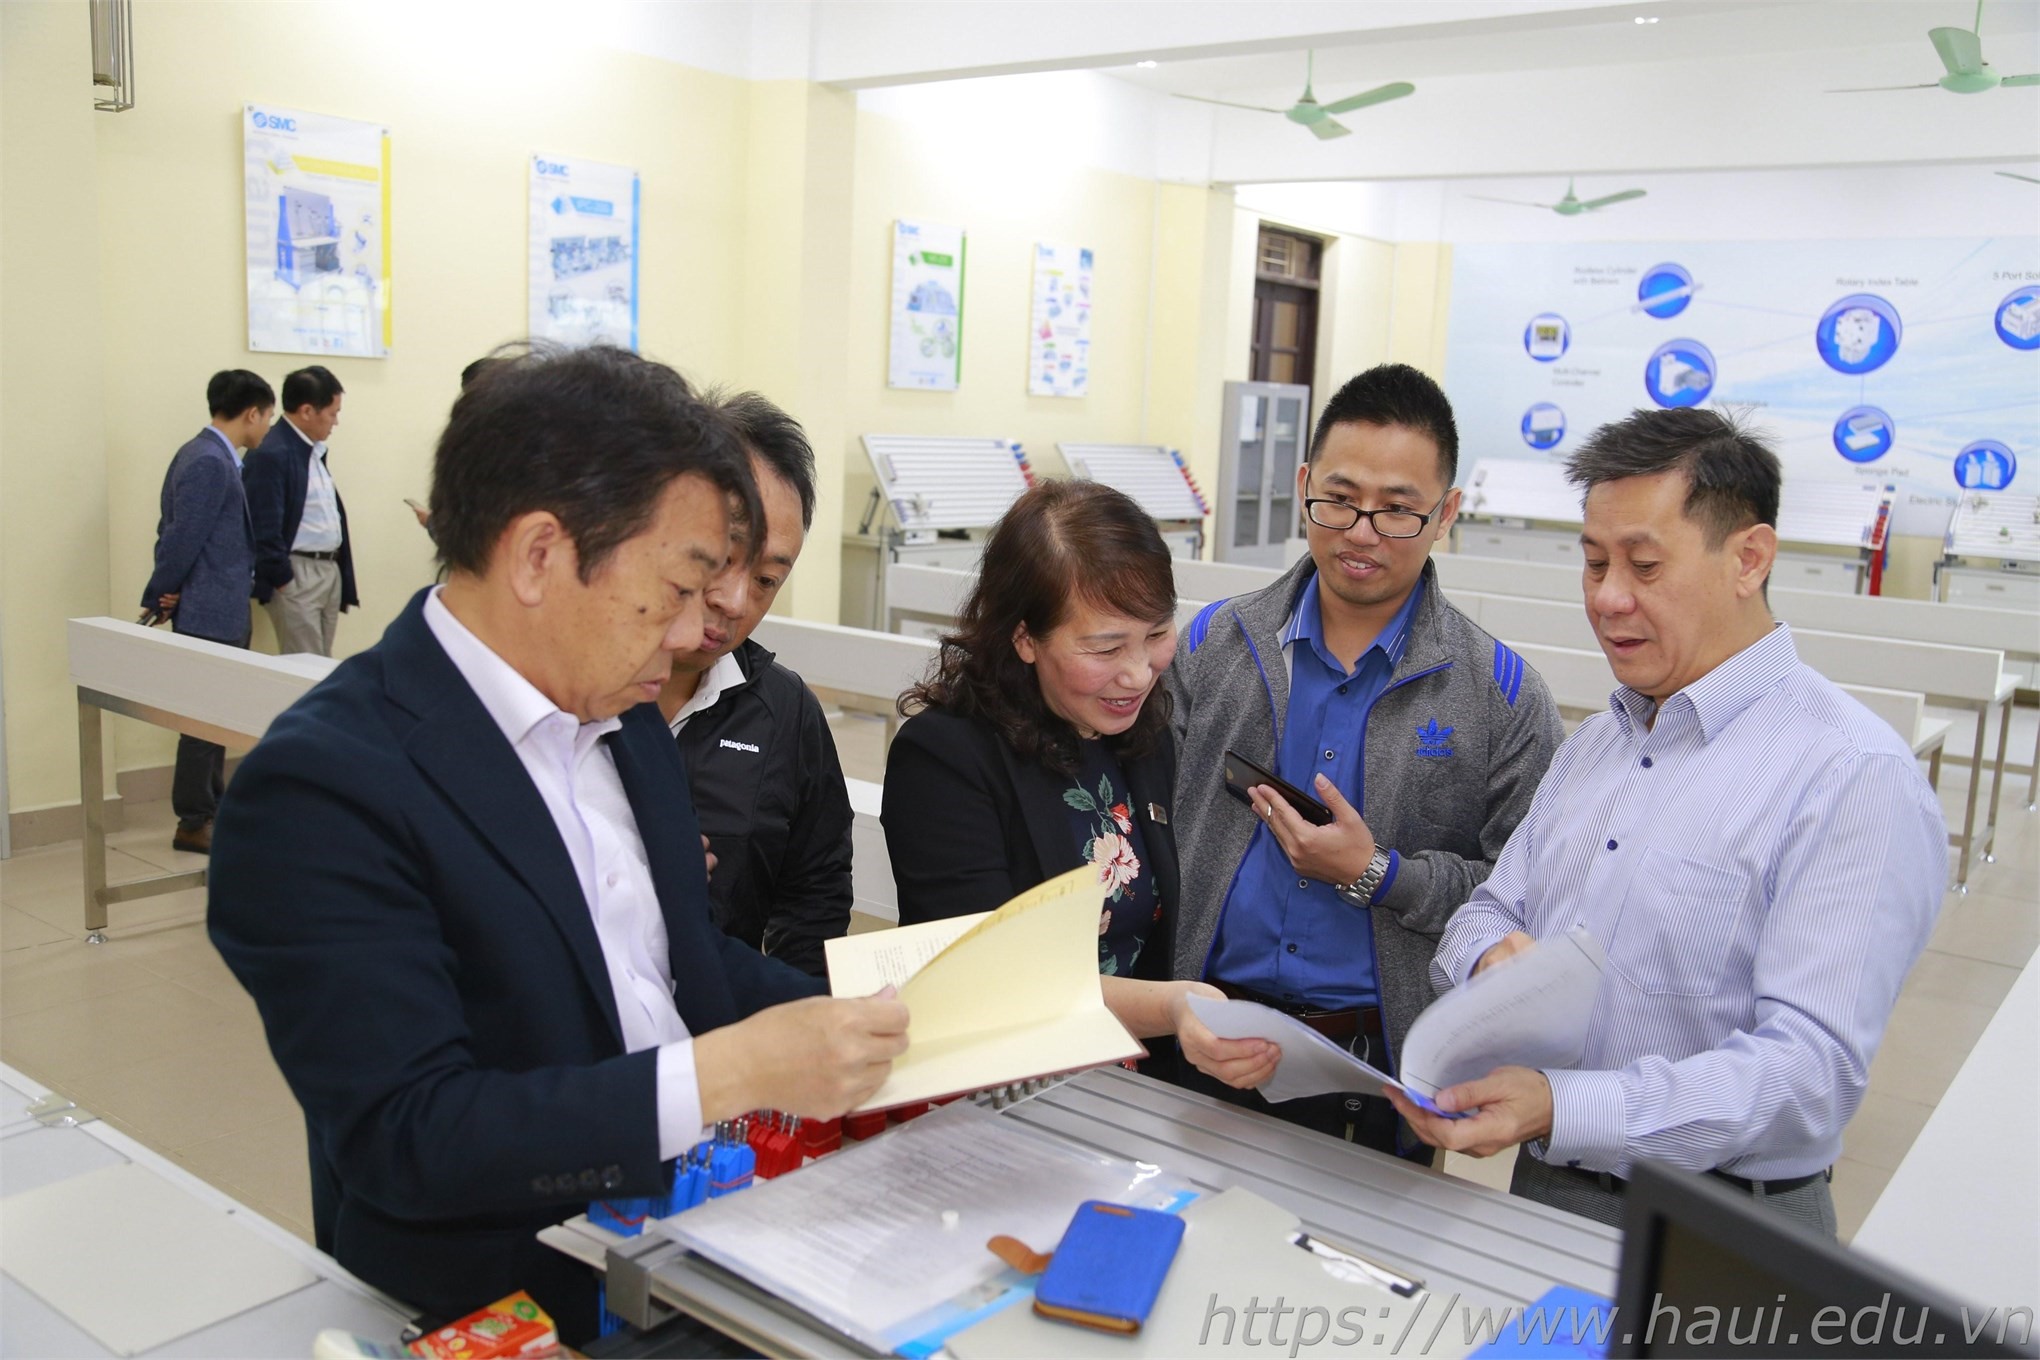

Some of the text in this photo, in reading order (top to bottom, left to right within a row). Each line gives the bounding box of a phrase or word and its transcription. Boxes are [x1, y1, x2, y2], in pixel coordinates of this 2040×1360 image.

[268, 115, 297, 132] SMC
[1836, 276, 1919, 288] Rotary Index Table
[2002, 271, 2022, 281] Port
[1891, 467, 1910, 478] Pad
[1909, 494, 1942, 506] Electric
[719, 738, 760, 753] patagonia
